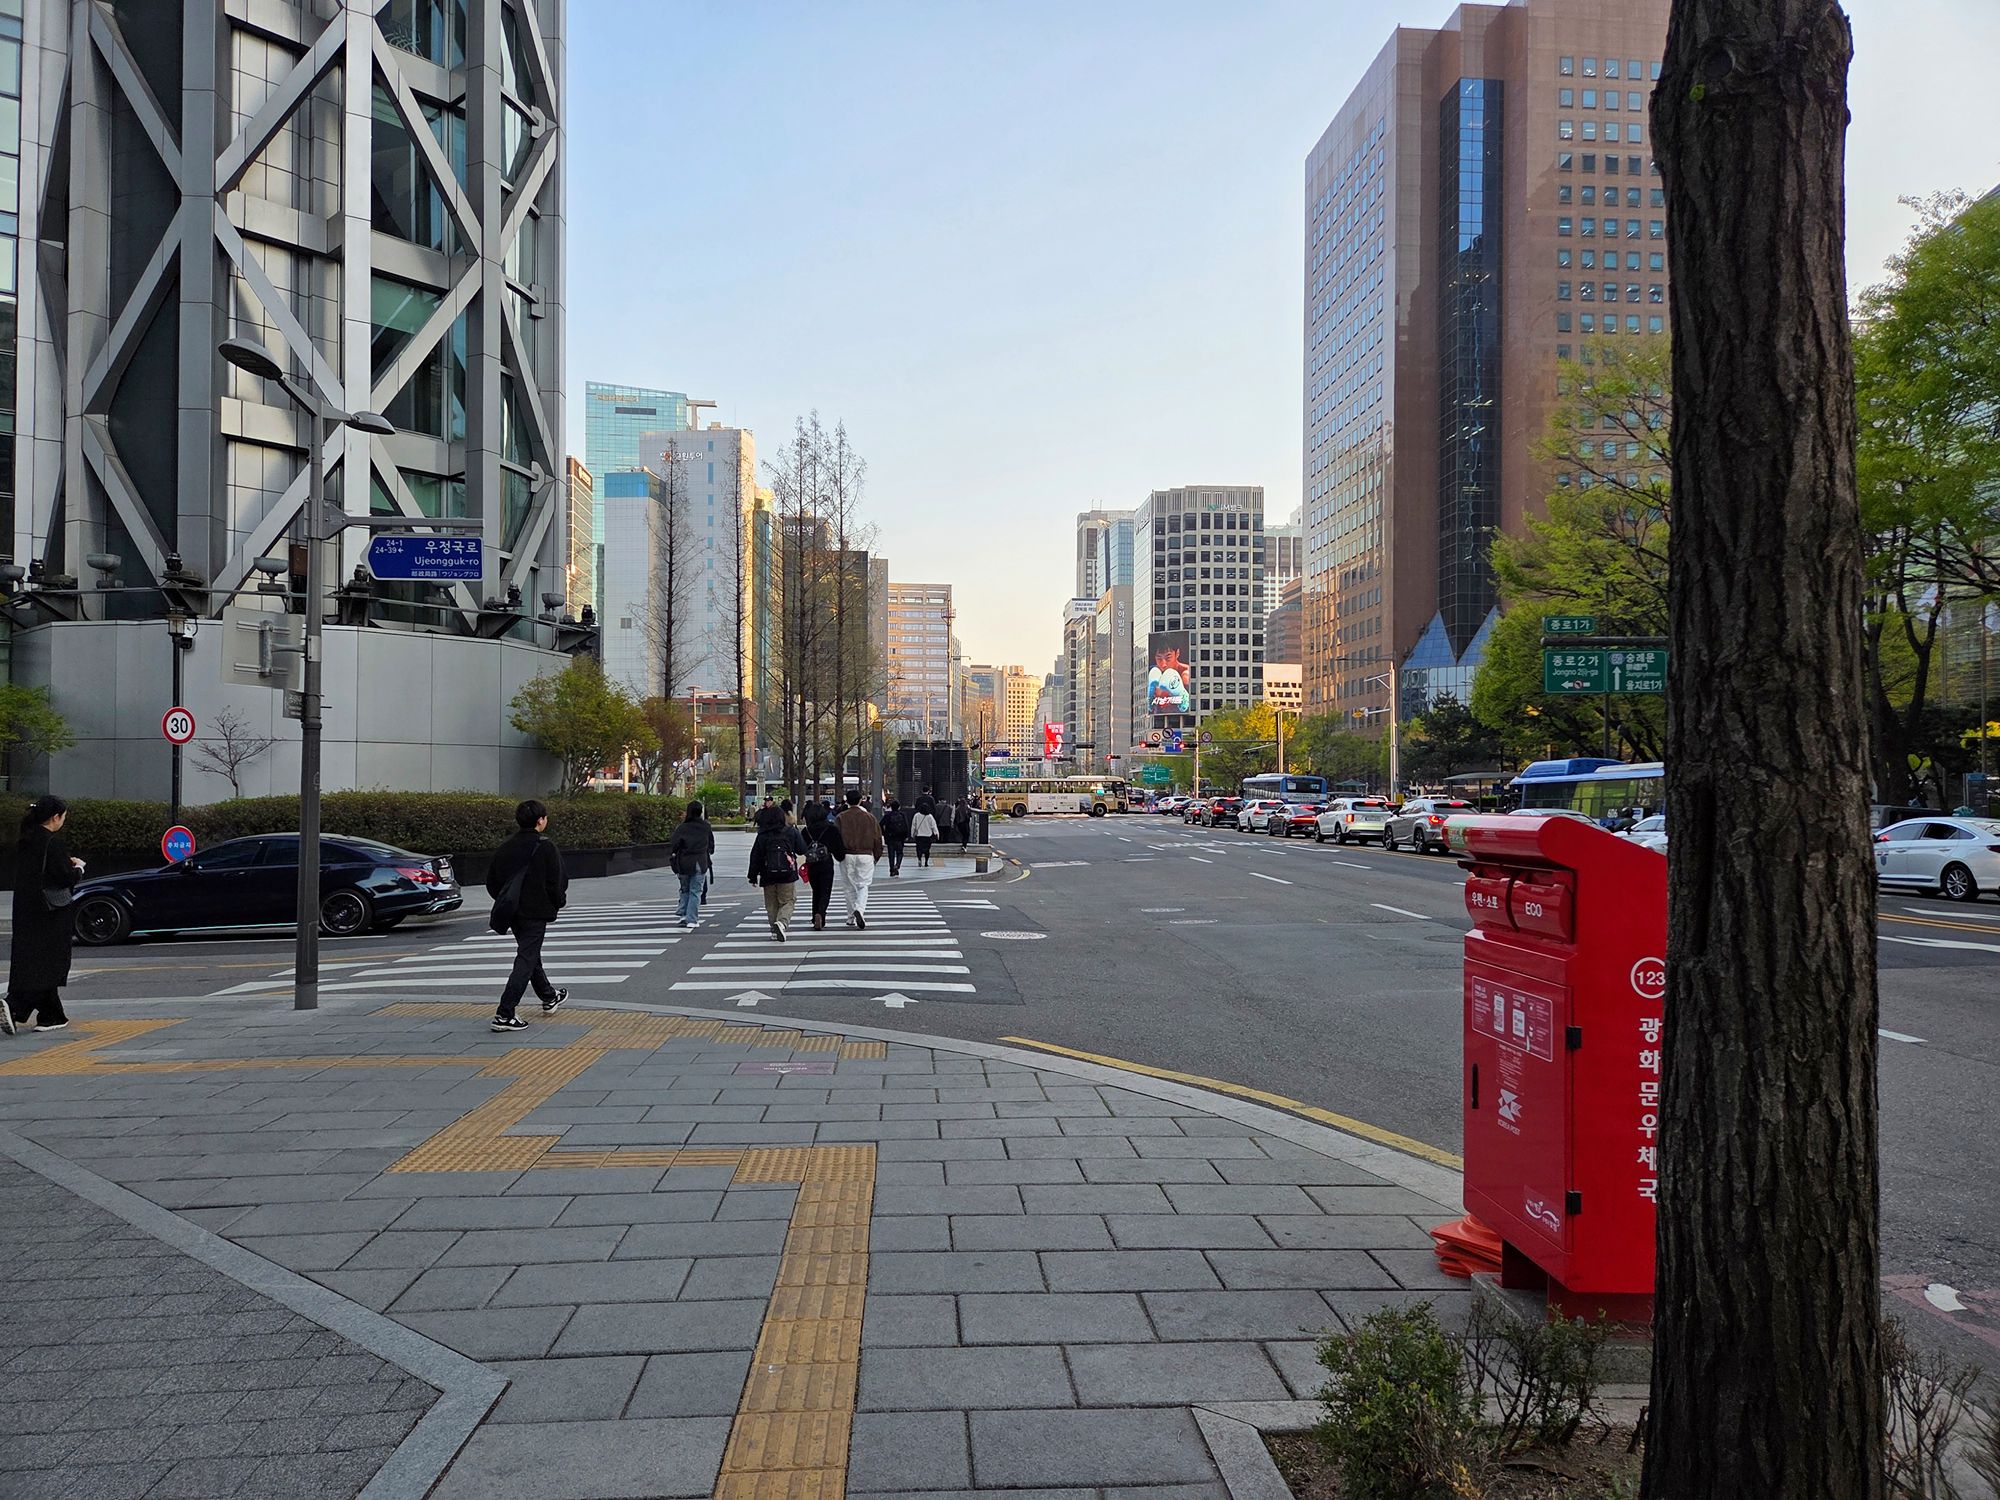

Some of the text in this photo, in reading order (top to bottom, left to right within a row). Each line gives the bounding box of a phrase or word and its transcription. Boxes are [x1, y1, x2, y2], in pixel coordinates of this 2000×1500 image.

[375, 546, 397, 554] 24-39
[425, 540, 479, 555] 우정국로
[414, 556, 480, 567] Ujeongguk-ro
[1117, 600, 1125, 637] 동아빌딩
[1551, 619, 1590, 630] 종로1가
[1626, 653, 1655, 663] 숭례문
[1552, 668, 1577, 677] Jongno
[1625, 680, 1662, 691] 을지로1가
[170, 718, 189, 734] 30
[1471, 891, 1499, 909] 우편·소포
[1525, 902, 1542, 917] ECO
[1636, 971, 1665, 986] 123
[1637, 1018, 1663, 1204] 광화문우체국
